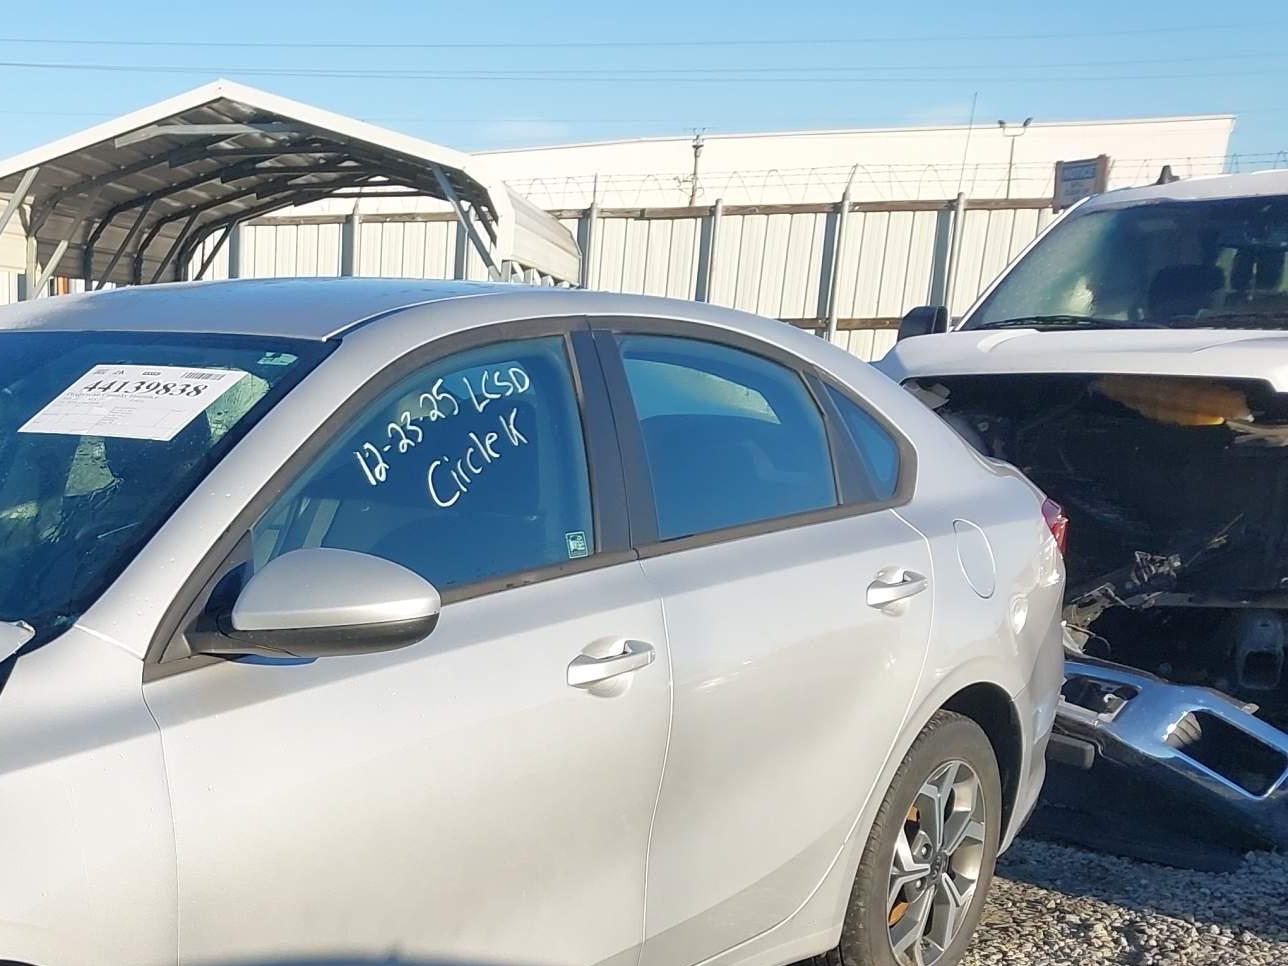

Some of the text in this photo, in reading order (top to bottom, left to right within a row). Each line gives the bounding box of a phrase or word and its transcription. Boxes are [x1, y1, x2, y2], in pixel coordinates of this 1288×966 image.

[83, 379, 209, 398] 44139838
[462, 367, 531, 413] LCSD
[427, 407, 529, 508] Circle K
